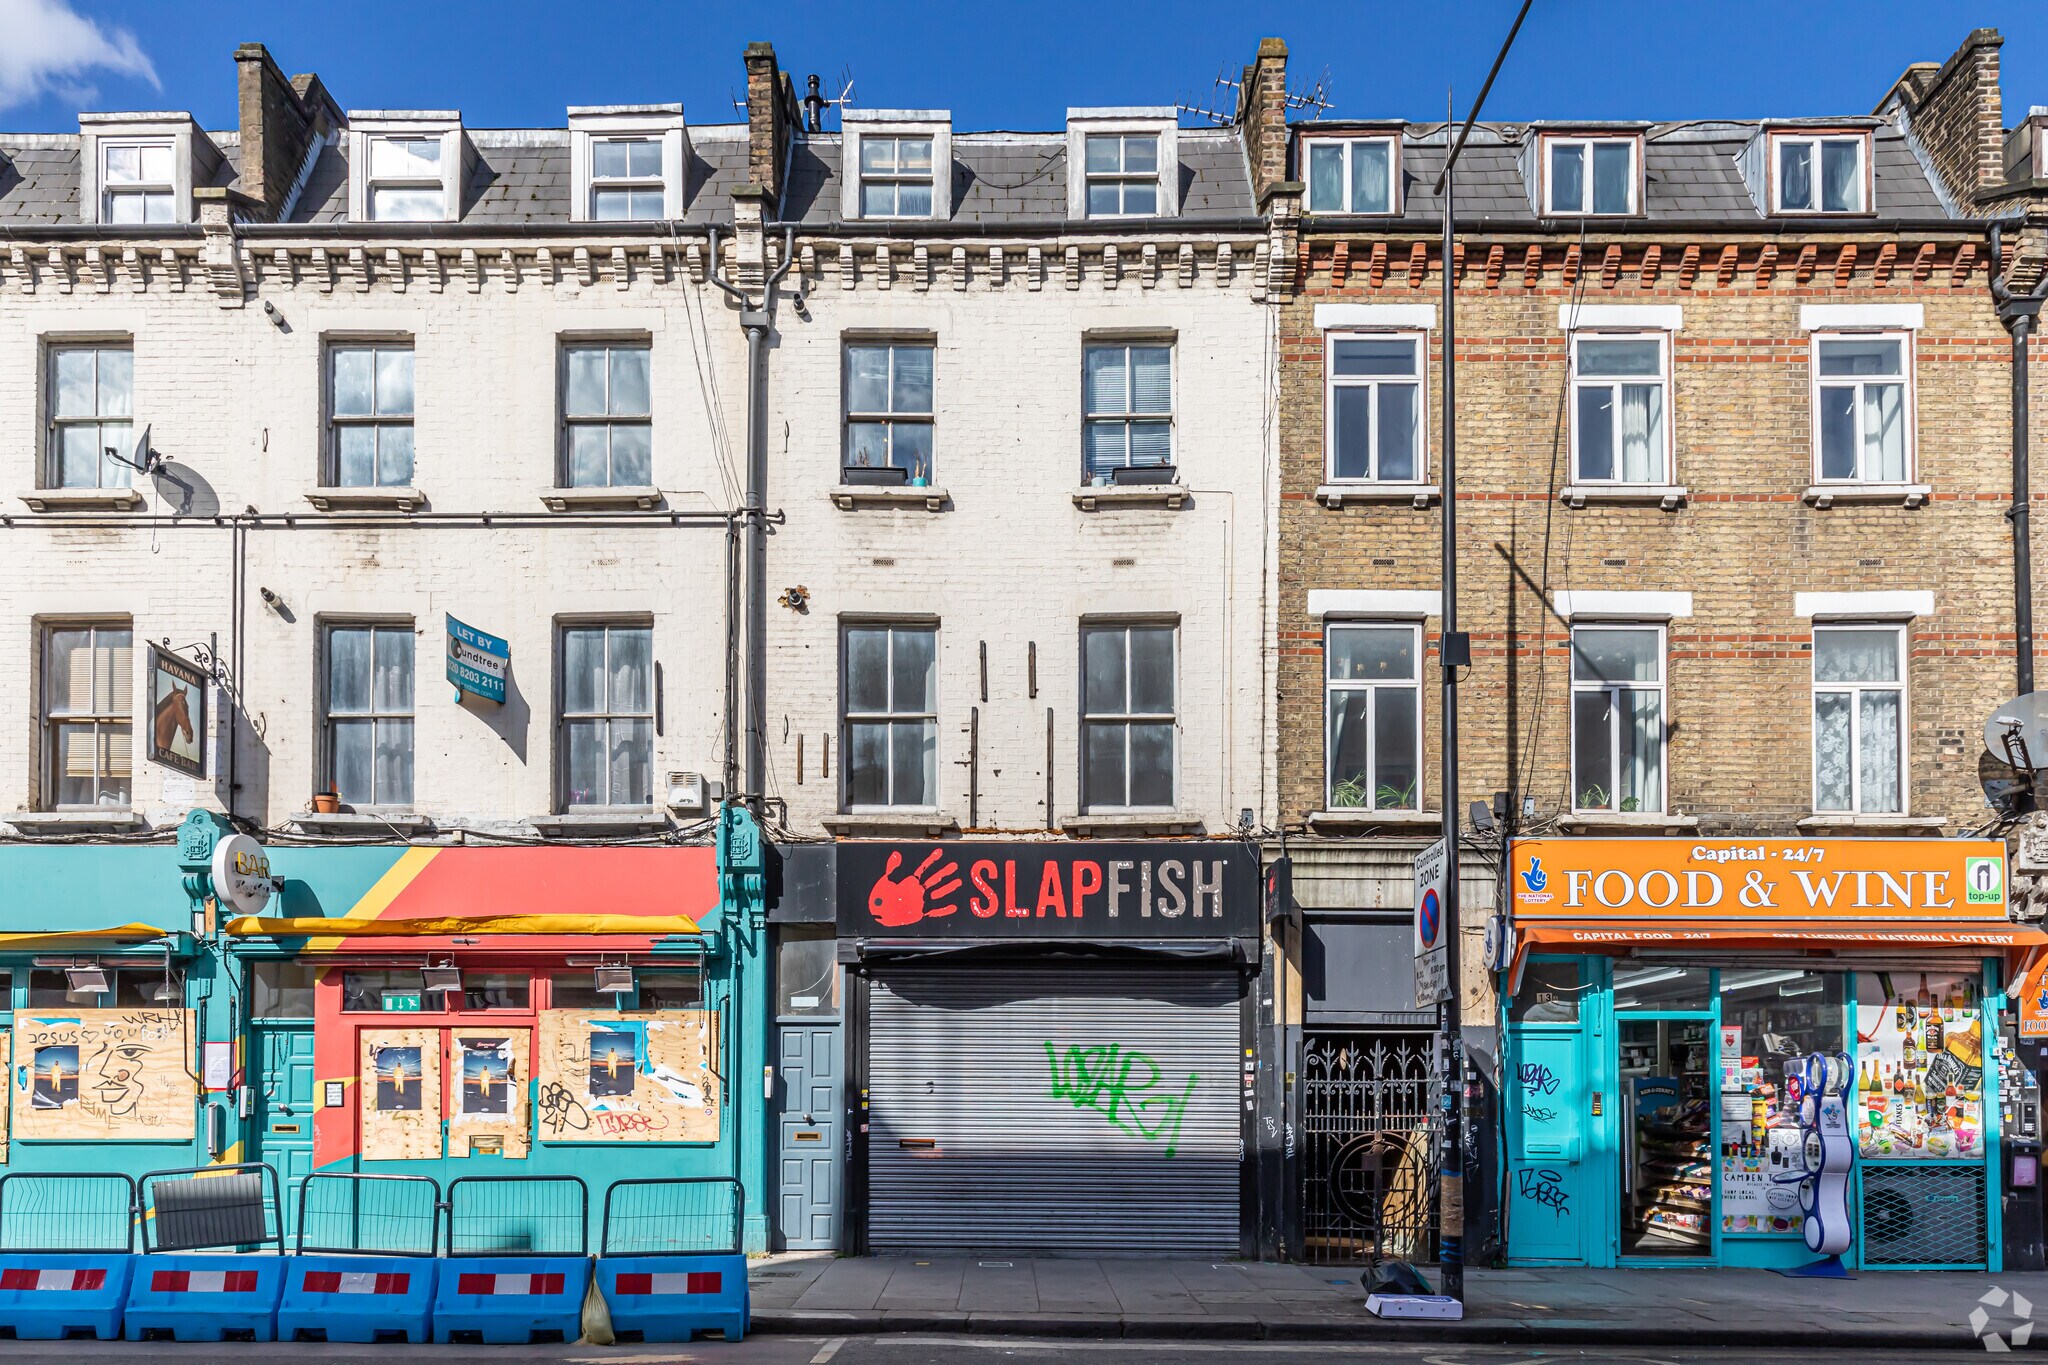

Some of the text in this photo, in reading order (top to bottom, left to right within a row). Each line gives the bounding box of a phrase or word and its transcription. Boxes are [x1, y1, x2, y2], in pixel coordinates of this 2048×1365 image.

[457, 626, 492, 650] LET BY
[161, 660, 196, 685] HAVANA
[448, 658, 504, 692] 020 8203 2111
[158, 749, 197, 771] CAFE BAR
[237, 851, 271, 880] BAR
[1416, 843, 1443, 870] Controlled
[1691, 845, 1765, 863] Capital
[1782, 847, 1825, 863] 24/7
[1420, 864, 1439, 888] ZONE
[969, 859, 1223, 918] SLAPFISH
[1562, 869, 1955, 909] FOOD & WINE
[1968, 891, 2000, 902] top-up
[1573, 933, 1632, 941] CAPITAL
[1802, 933, 1865, 941] LICENCE
[1875, 933, 1949, 942] NATIONAL
[1953, 934, 2014, 944] LOTTERY
[2024, 1020, 2048, 1032] FOO
[1724, 1173, 1763, 1182] CAMDEN
